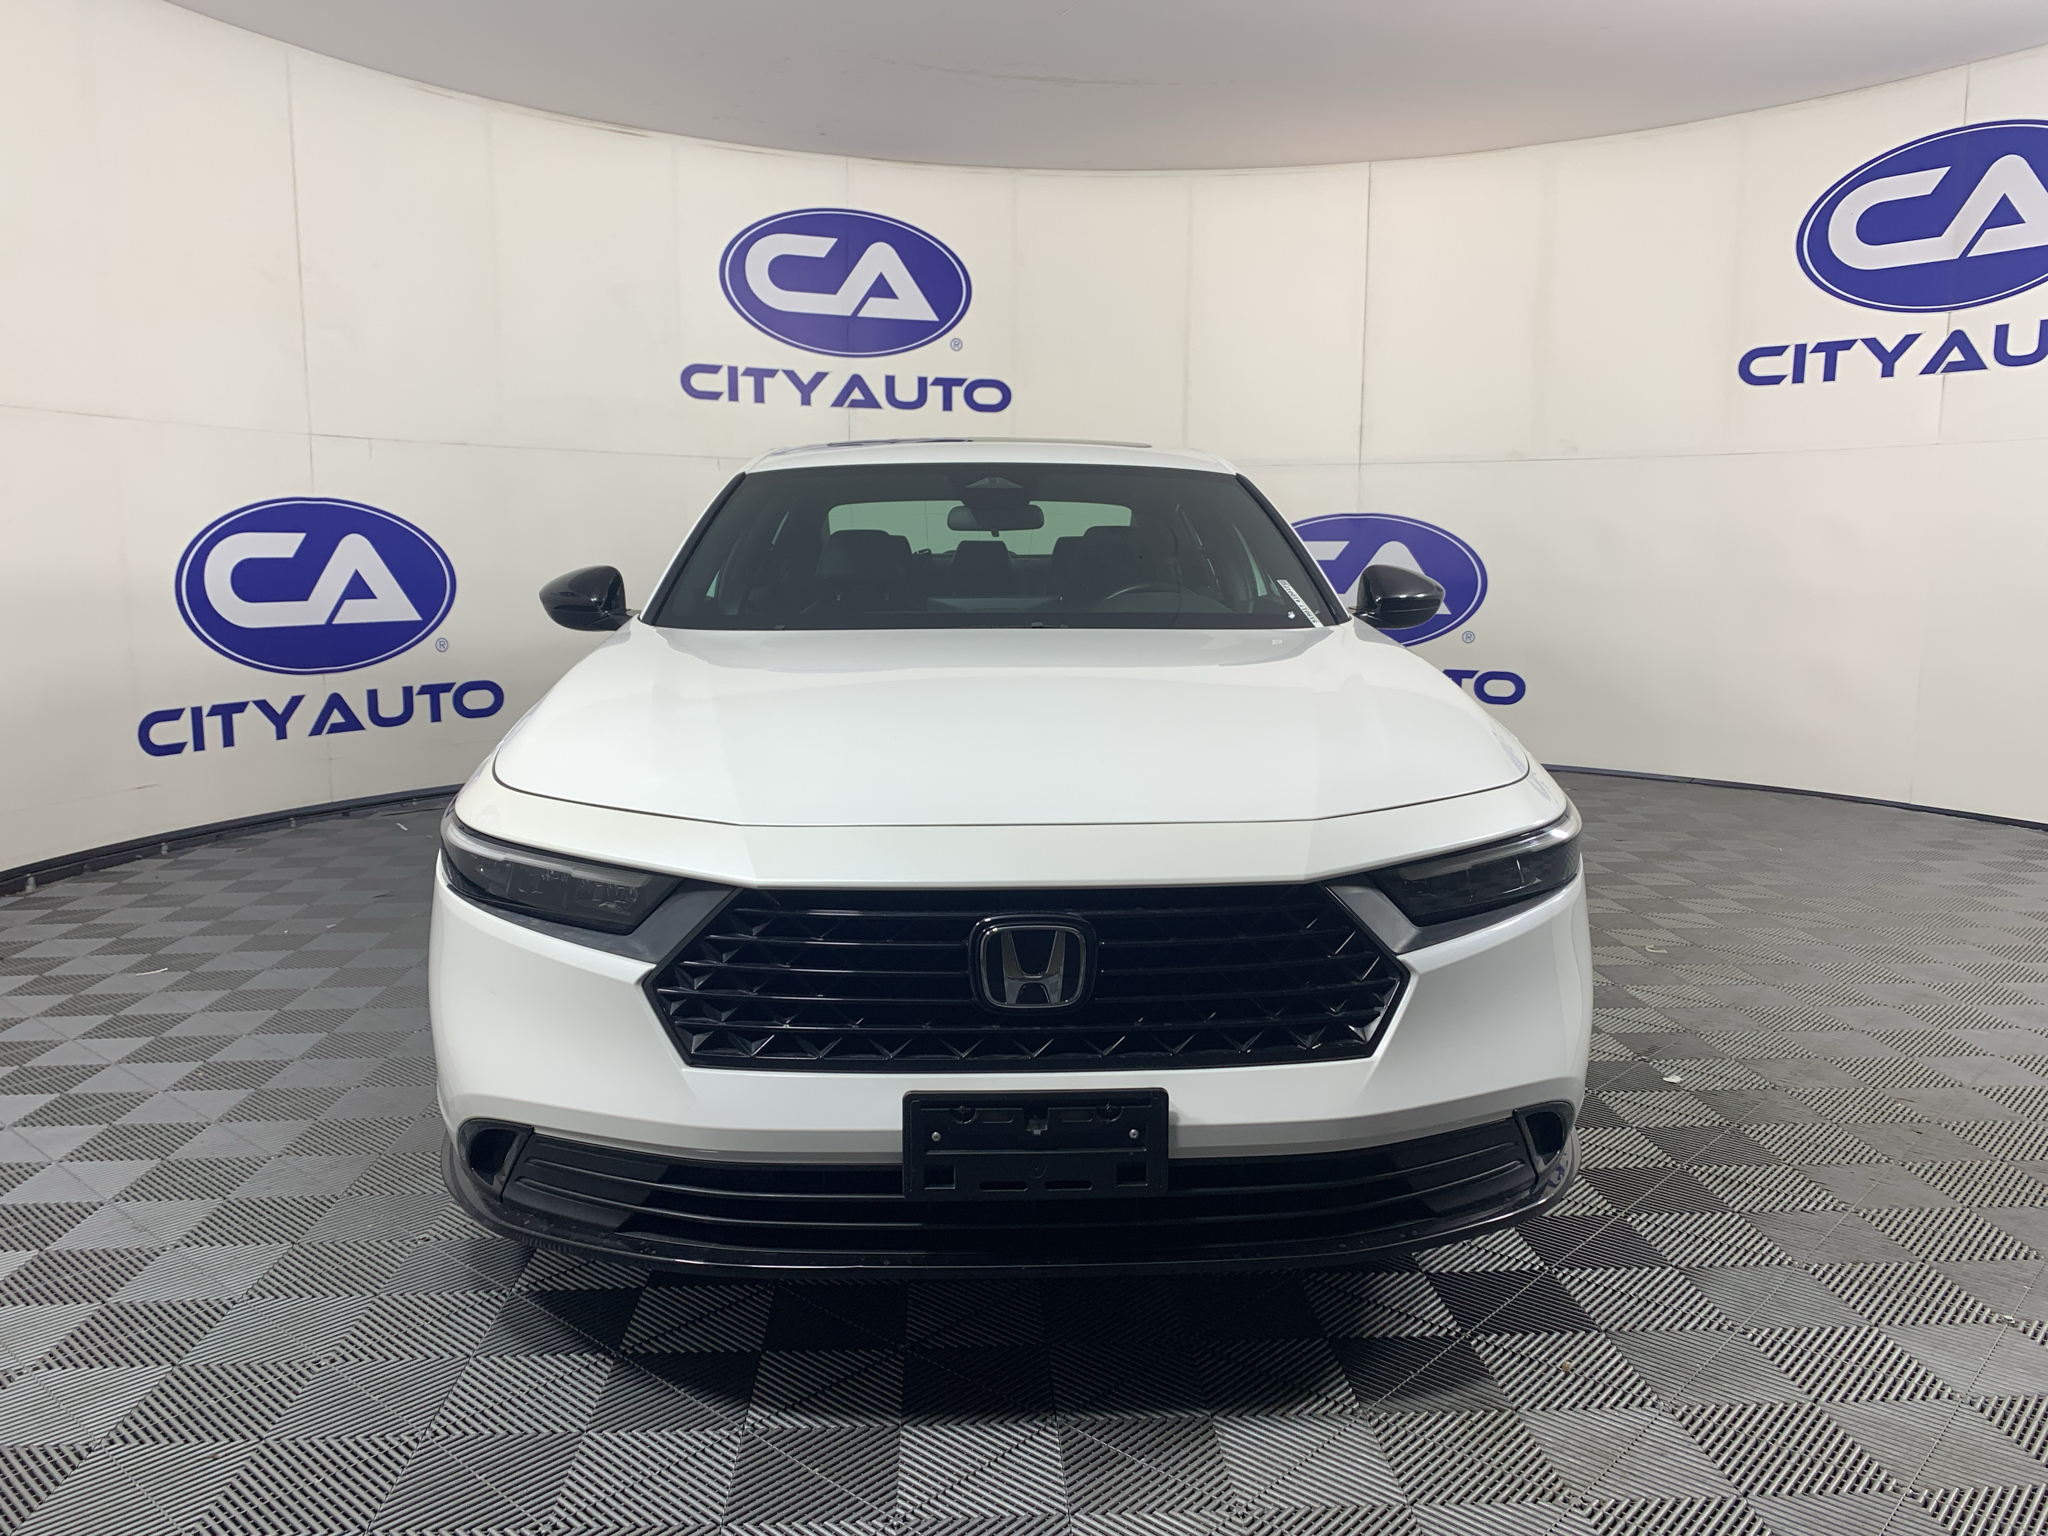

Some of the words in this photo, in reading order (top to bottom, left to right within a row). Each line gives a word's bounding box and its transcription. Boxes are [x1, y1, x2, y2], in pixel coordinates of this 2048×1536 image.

[1828, 154, 2048, 270] CA
[745, 233, 939, 321] CA
[204, 532, 422, 628] CA
